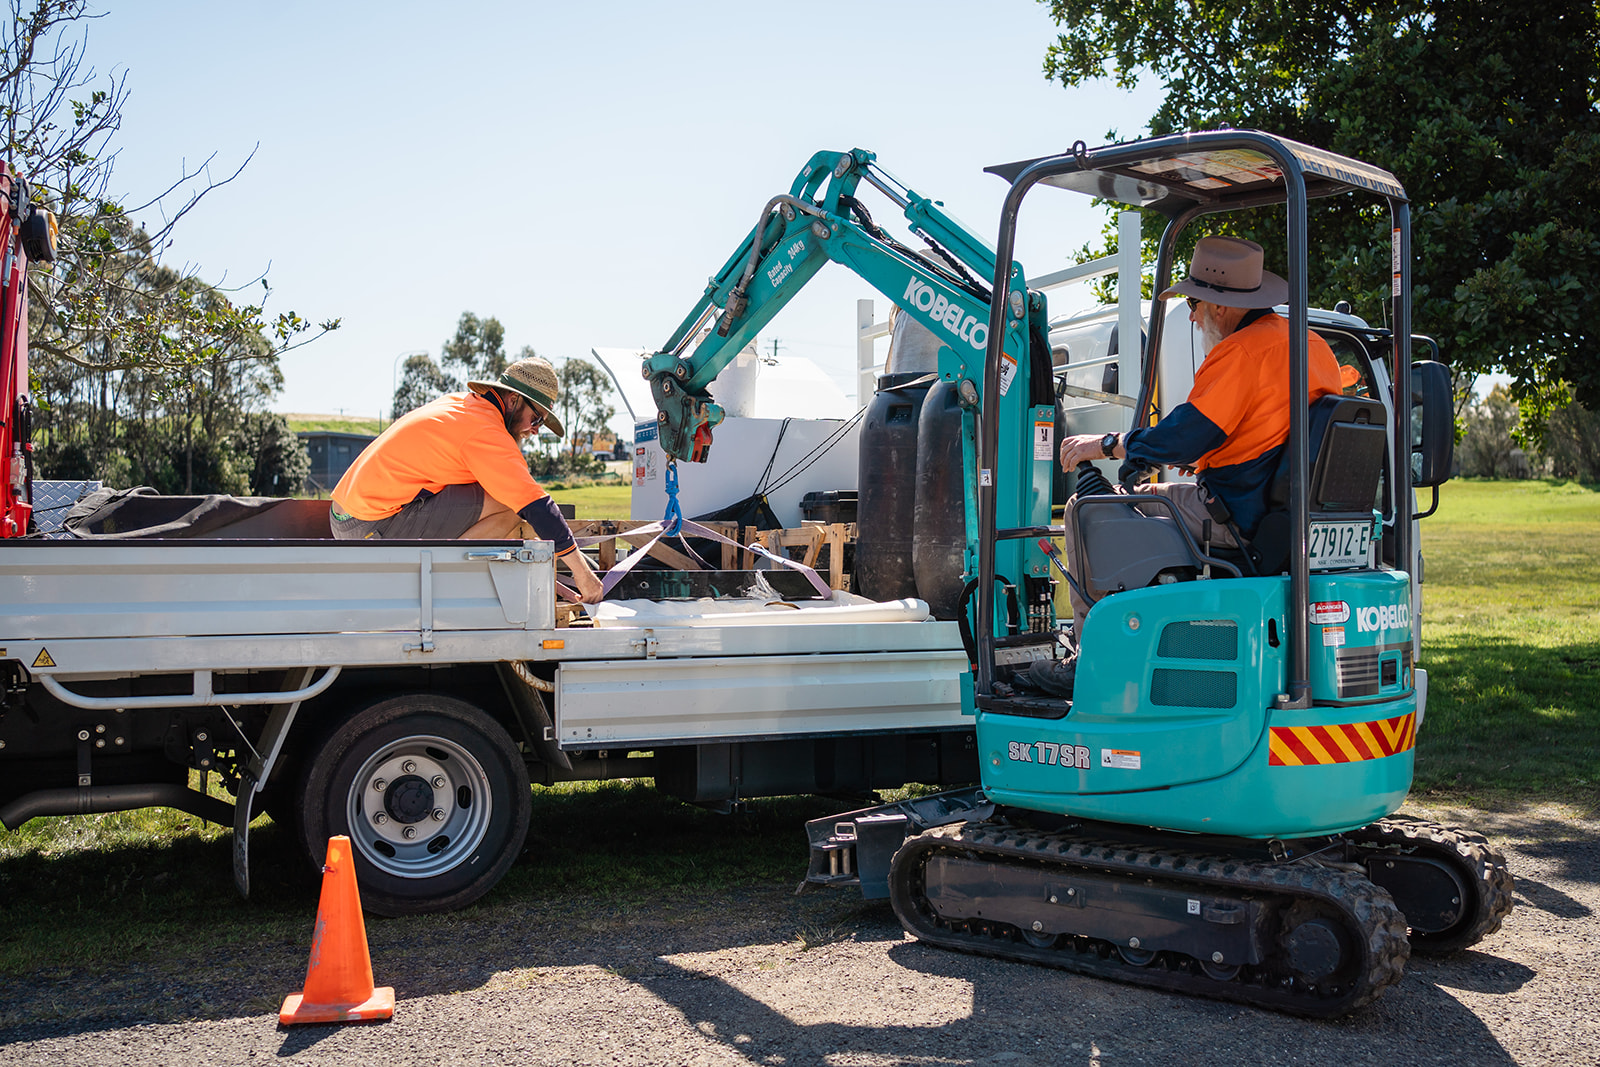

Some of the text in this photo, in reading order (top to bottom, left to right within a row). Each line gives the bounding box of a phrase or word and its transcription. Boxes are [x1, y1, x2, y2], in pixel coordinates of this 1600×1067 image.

[767, 260, 782, 280] Rated
[771, 263, 793, 288] Capacity
[902, 275, 989, 350] KOBELCO
[1356, 603, 1409, 632] KOBELCO
